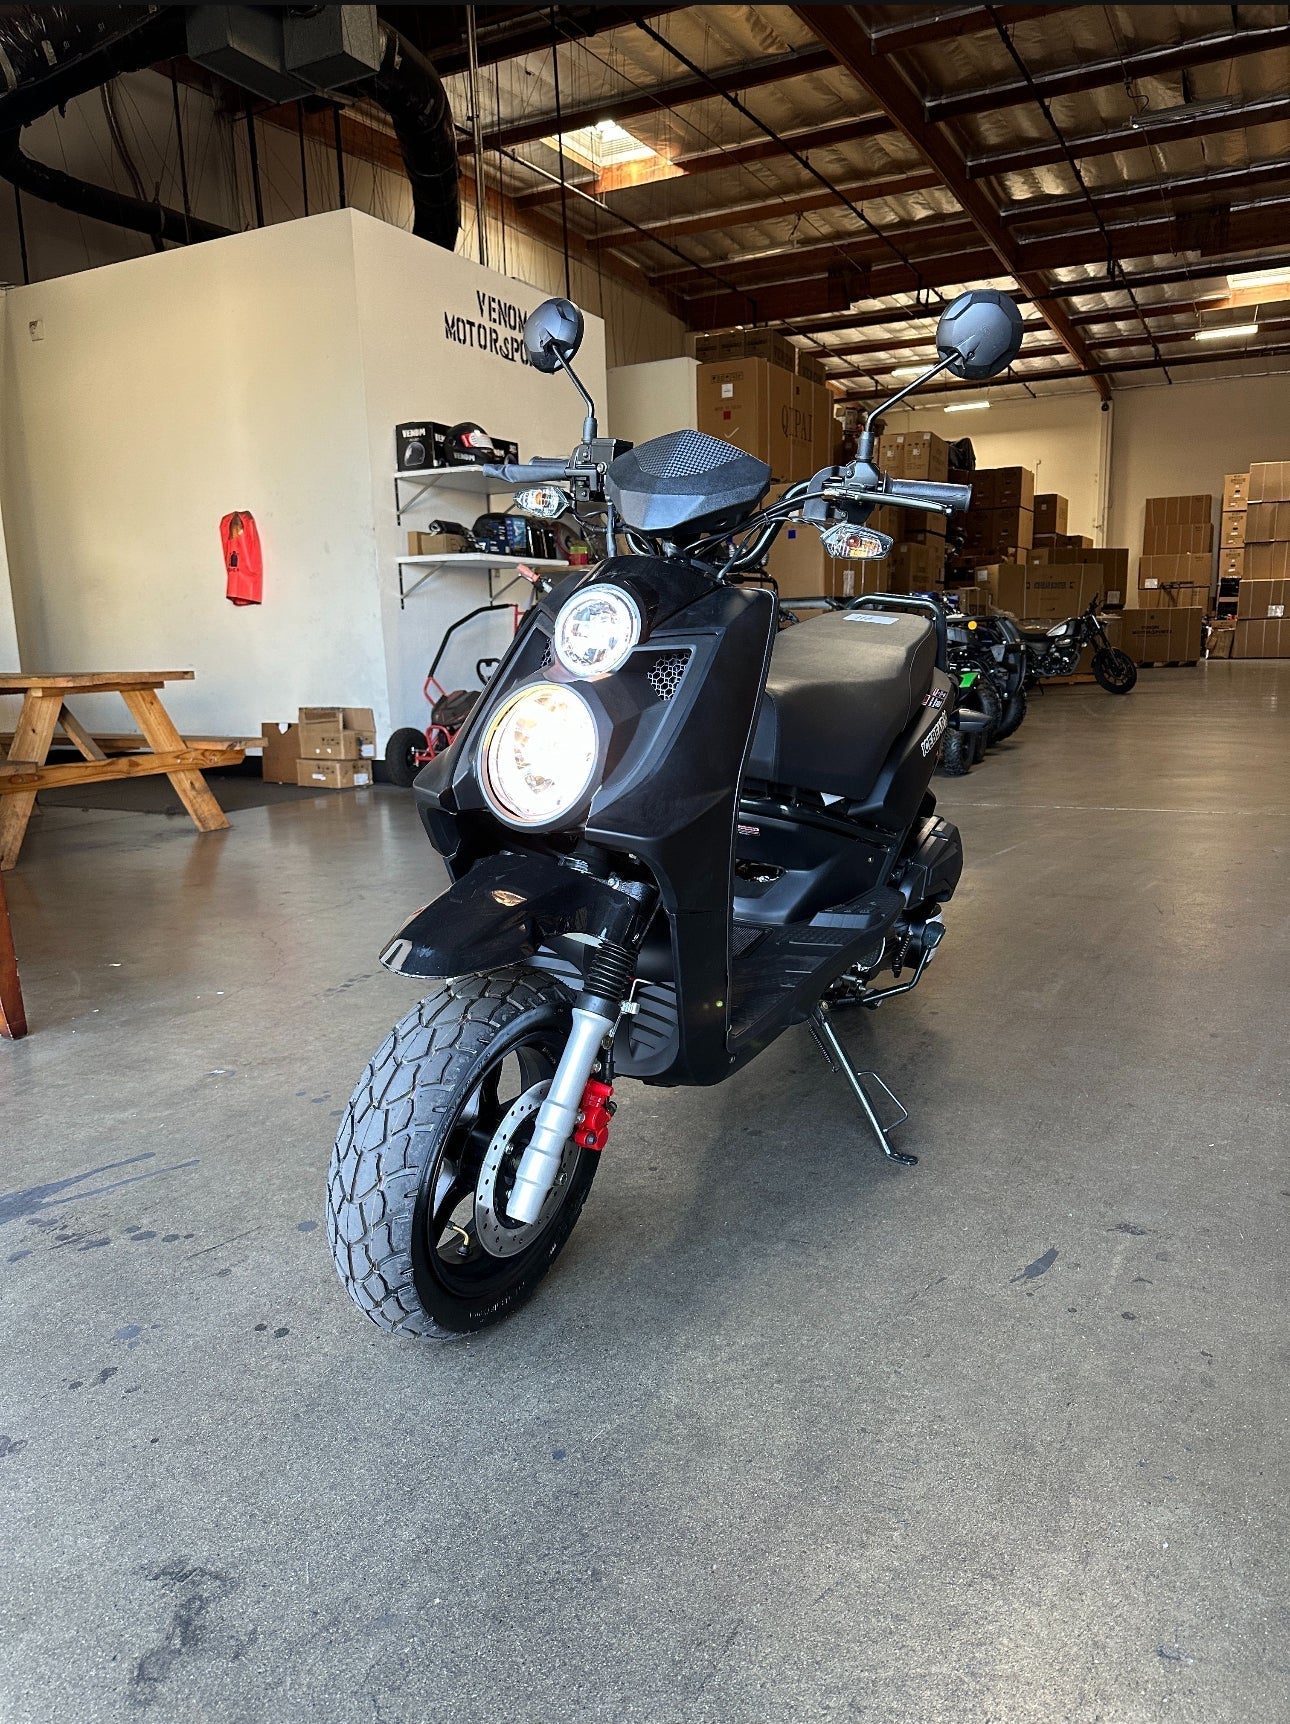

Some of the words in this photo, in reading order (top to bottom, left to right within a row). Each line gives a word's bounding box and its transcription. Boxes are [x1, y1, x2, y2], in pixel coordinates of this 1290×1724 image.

[476, 290, 528, 334] VENOM
[444, 311, 533, 367] MOTORSPO
[402, 428, 426, 438] VENOM
[453, 452, 476, 462] VENOM
